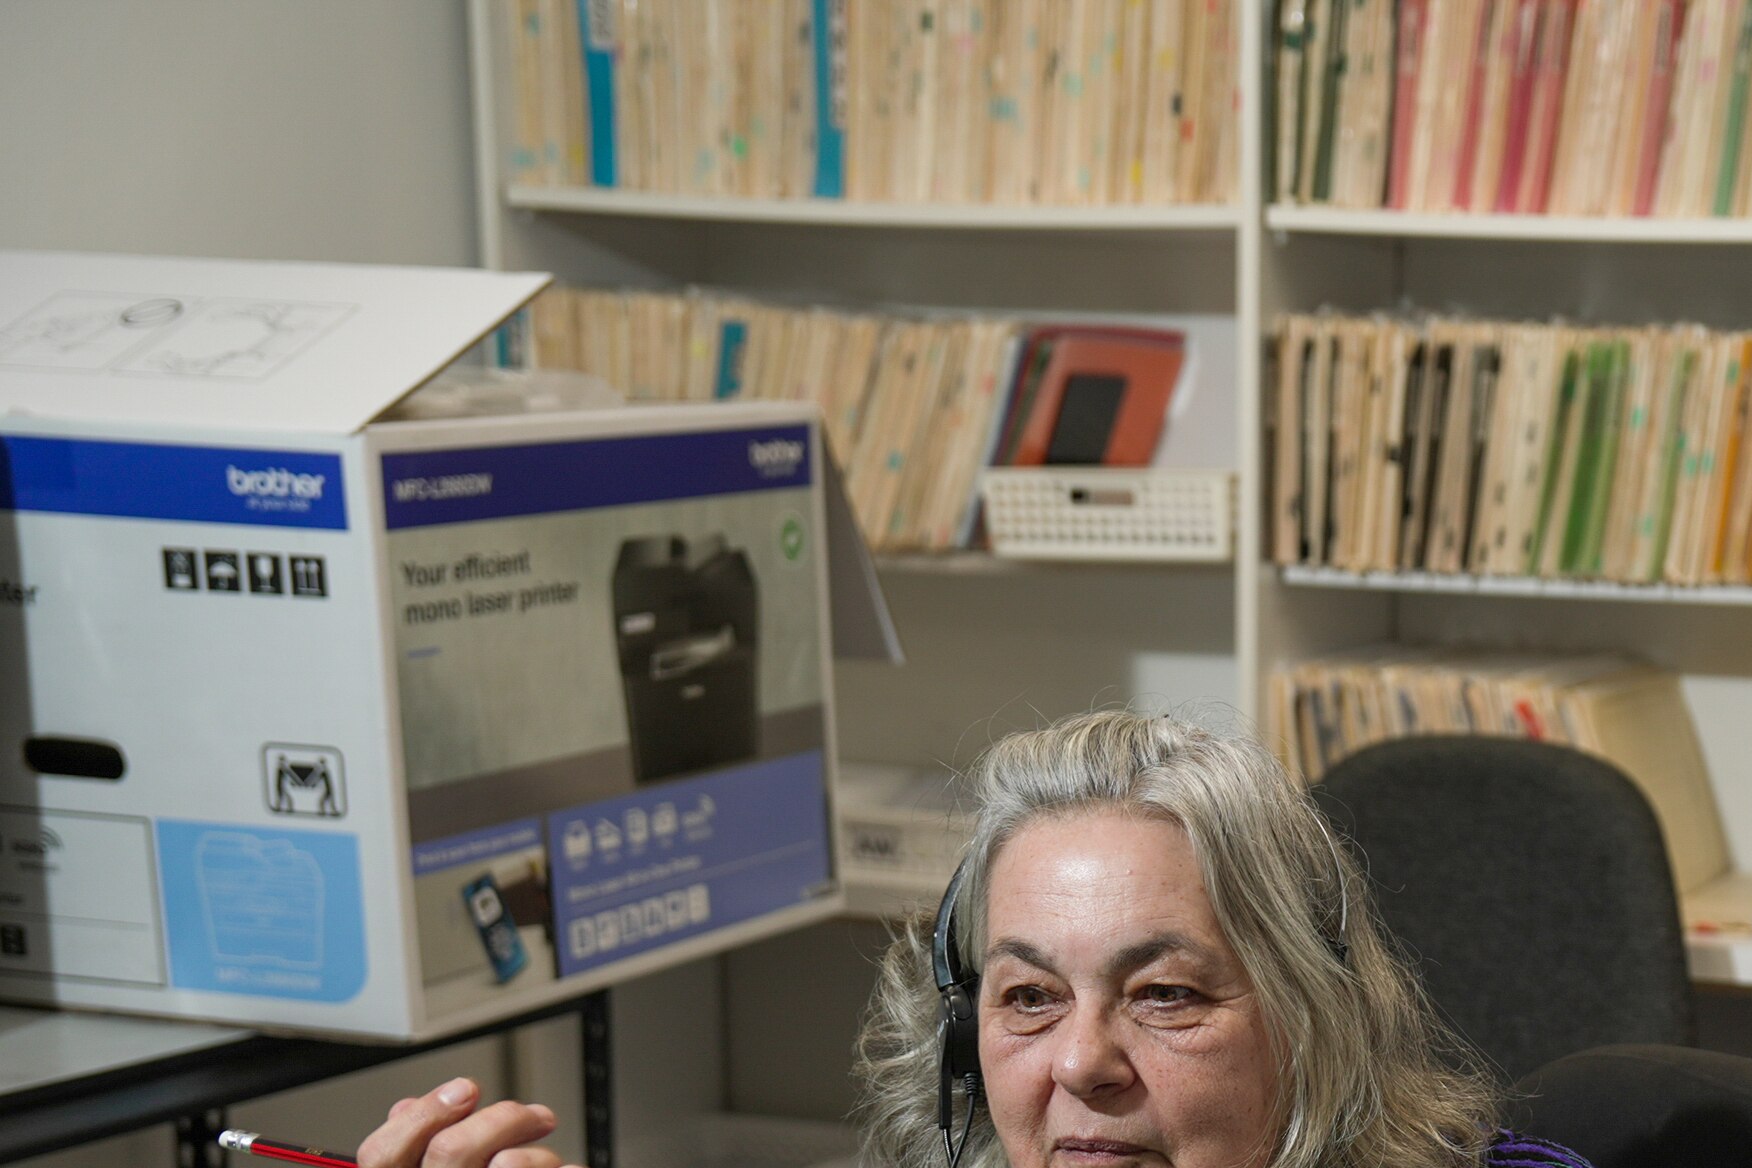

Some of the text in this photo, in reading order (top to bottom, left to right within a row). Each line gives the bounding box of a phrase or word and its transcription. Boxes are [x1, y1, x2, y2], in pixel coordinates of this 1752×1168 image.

[227, 465, 324, 498] brother
[403, 552, 530, 586] Your efficient
[406, 582, 577, 623] mono laser printer
